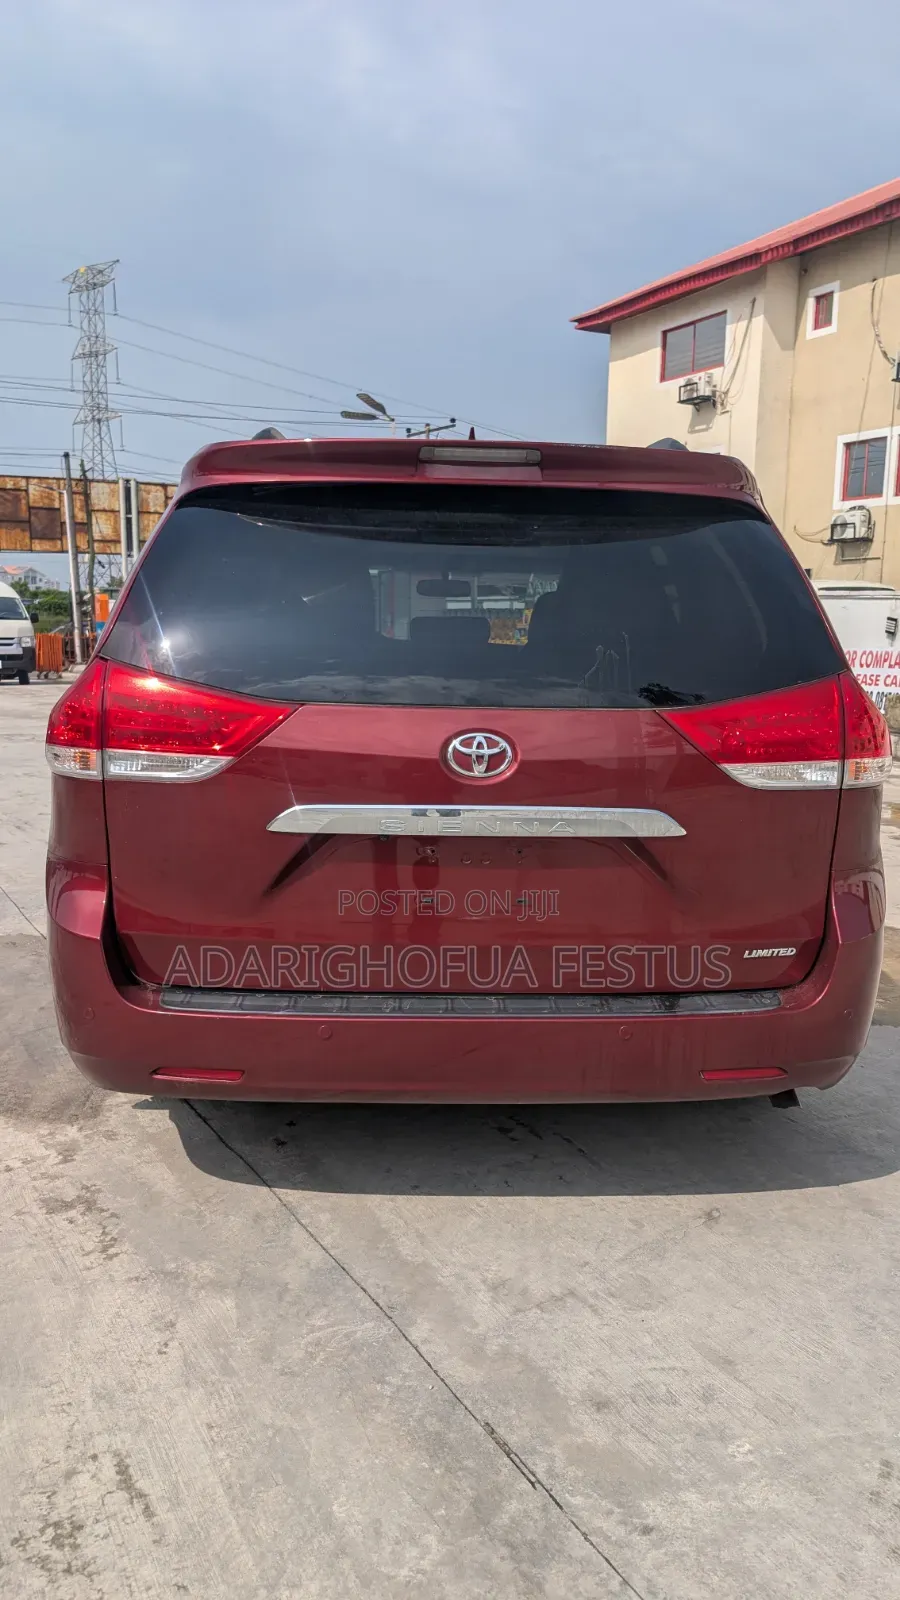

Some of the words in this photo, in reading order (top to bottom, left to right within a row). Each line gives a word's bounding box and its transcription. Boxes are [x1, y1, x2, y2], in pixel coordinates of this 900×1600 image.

[883, 674, 900, 688] CA
[379, 819, 577, 833] SIENNA
[743, 947, 797, 959] LIMITED
